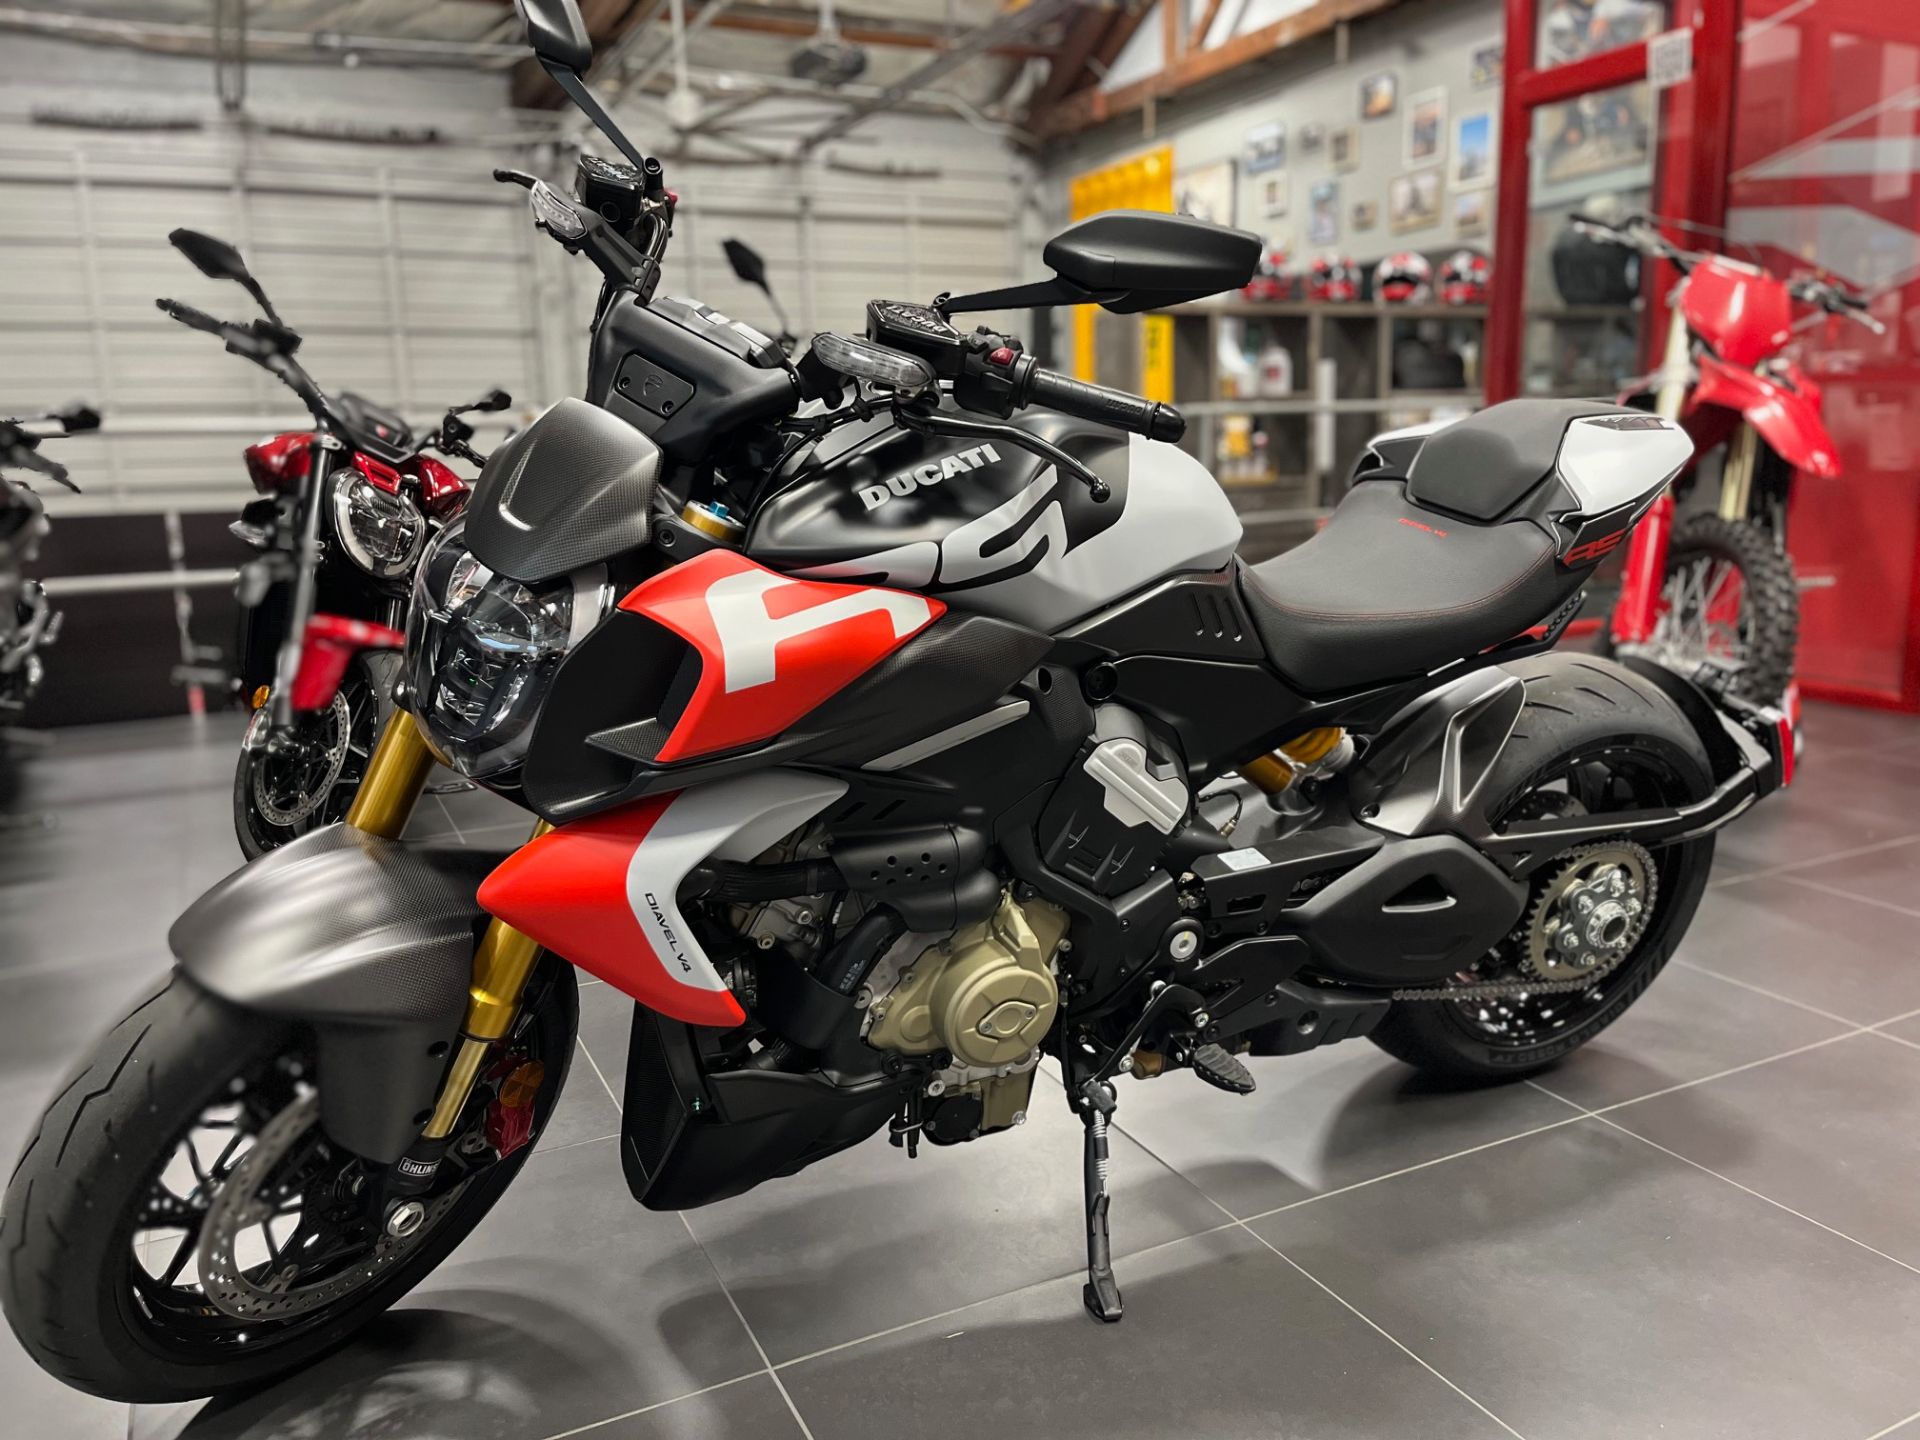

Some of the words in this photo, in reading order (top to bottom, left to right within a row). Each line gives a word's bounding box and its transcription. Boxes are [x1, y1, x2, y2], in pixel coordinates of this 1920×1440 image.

[858, 443, 1001, 511] DUCATI
[645, 892, 678, 952] DIAVEL
[677, 952, 692, 973] V4
